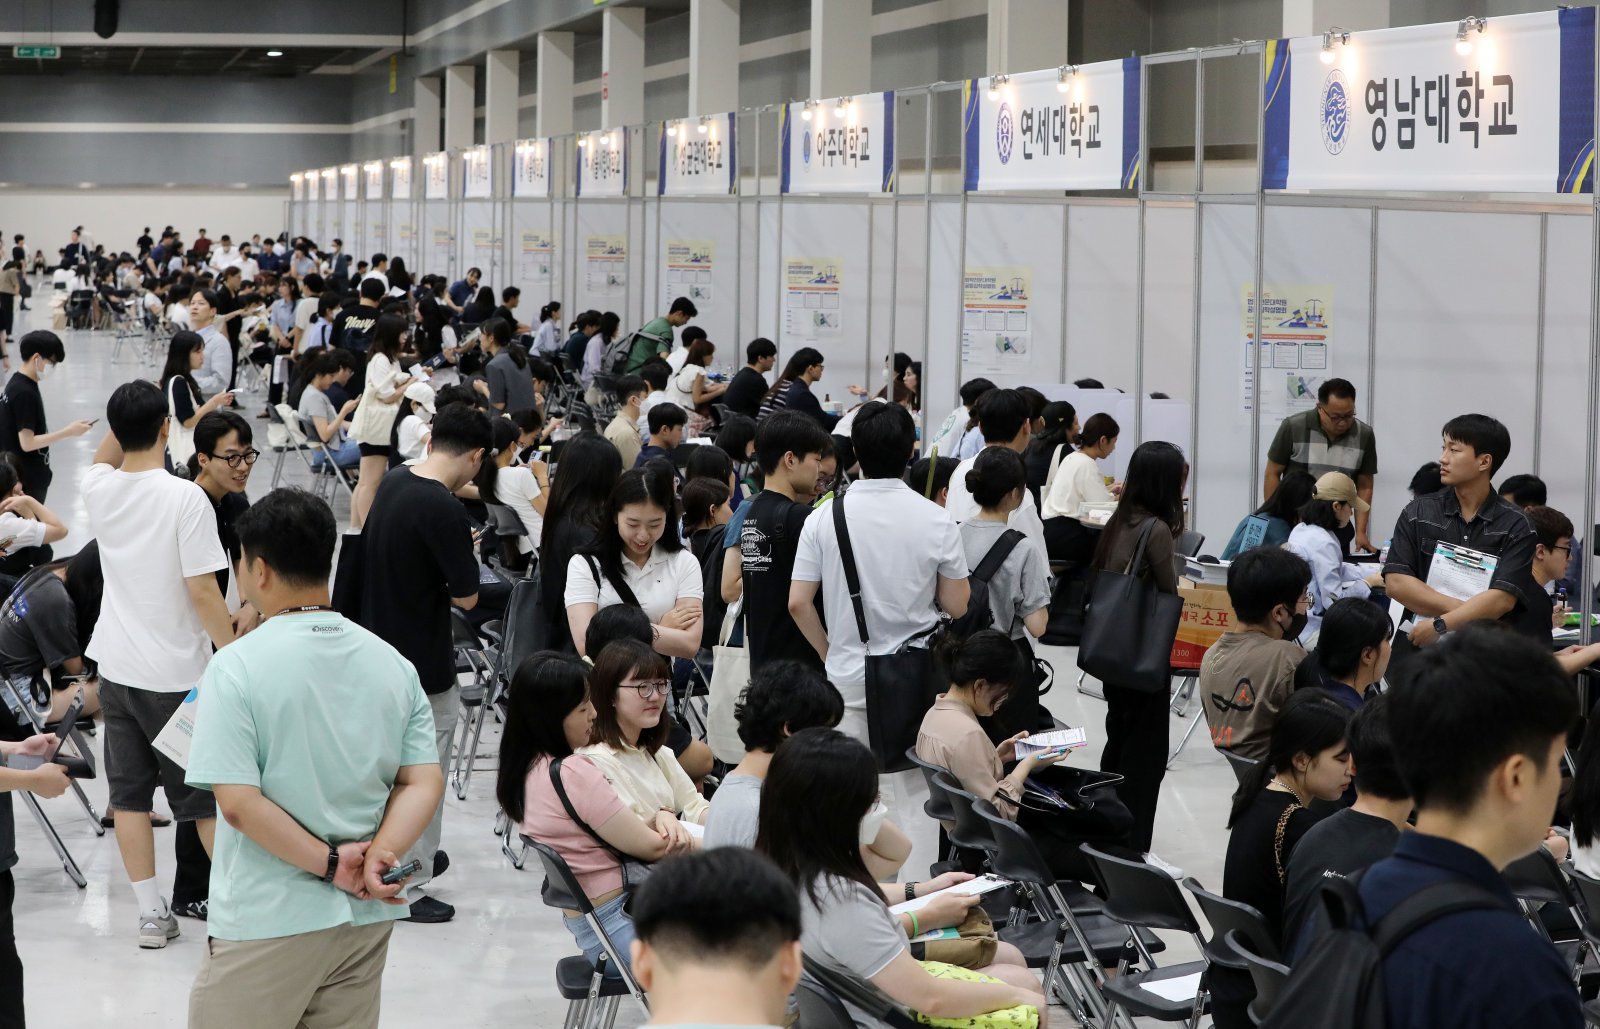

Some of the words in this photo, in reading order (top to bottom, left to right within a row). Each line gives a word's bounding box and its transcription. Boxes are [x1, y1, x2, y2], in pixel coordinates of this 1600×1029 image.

[1365, 70, 1517, 151] 영남대학교
[817, 124, 870, 168] 아주대학교
[1021, 102, 1101, 160] 연세대학교
[680, 139, 723, 176] 성균관대학교
[344, 315, 376, 333] Navy
[1200, 610, 1229, 627] 소포
